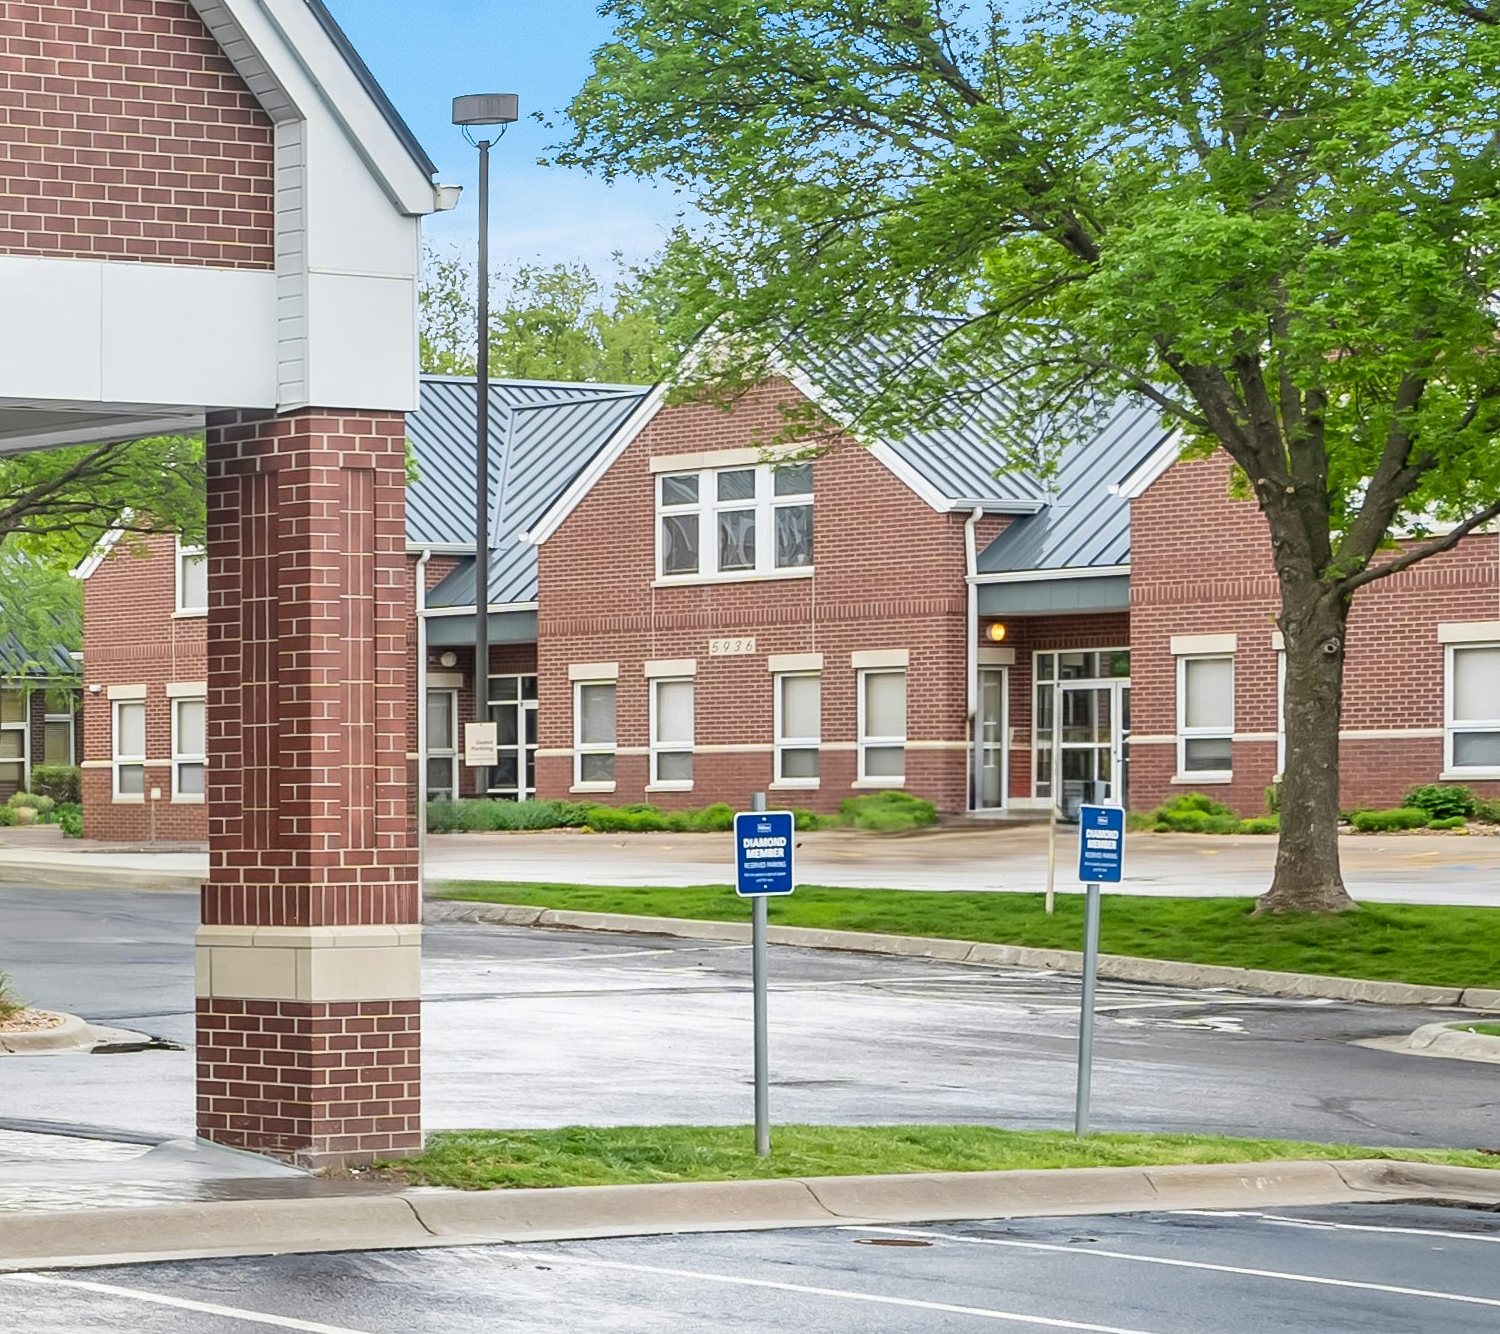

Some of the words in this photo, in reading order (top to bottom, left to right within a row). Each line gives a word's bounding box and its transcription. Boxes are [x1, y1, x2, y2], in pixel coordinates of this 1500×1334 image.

[711, 640, 753, 653] 5936
[743, 836, 787, 848] DIAMOND
[746, 848, 784, 858] MEMBER
